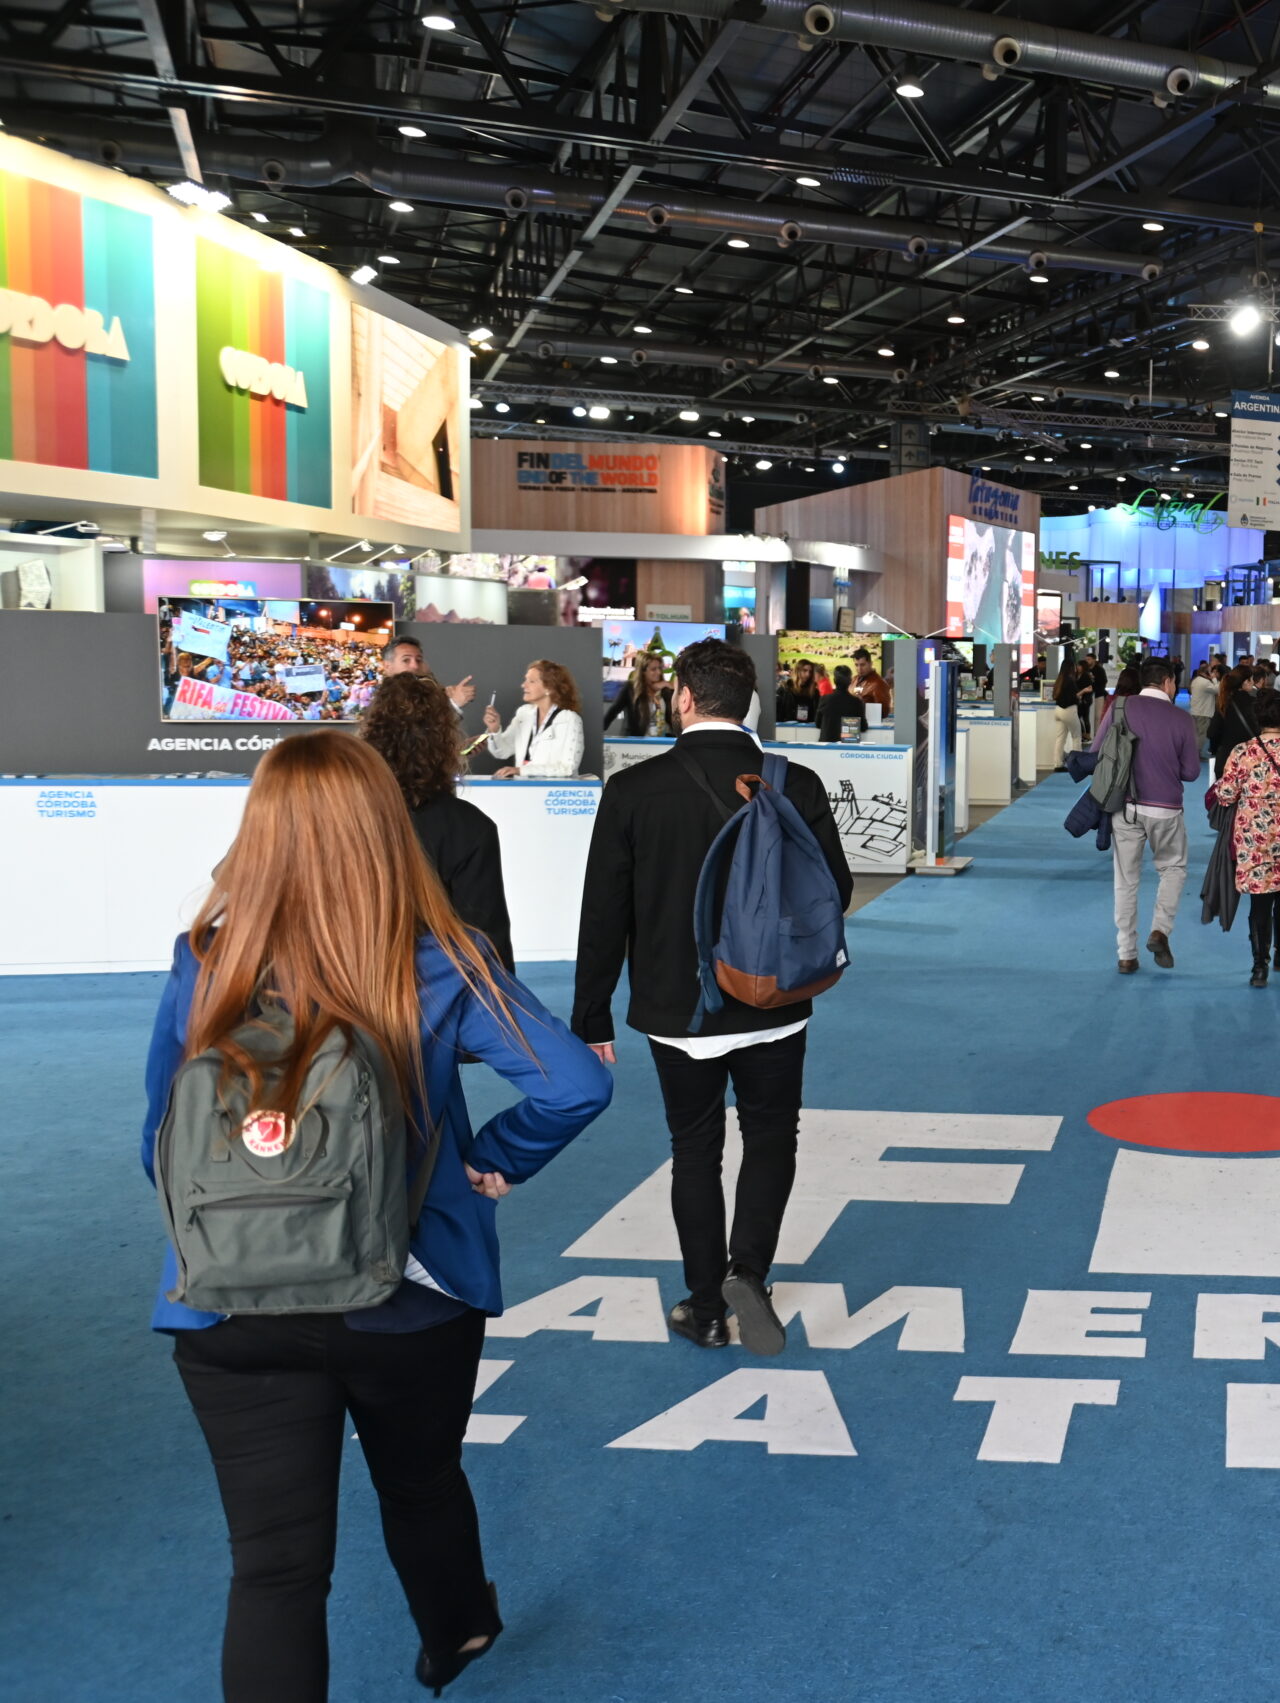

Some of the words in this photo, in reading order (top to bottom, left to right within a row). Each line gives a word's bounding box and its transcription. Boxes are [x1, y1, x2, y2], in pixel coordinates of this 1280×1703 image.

[517, 452, 550, 469] FIN
[588, 454, 657, 471] MUNDO
[549, 471, 568, 484] OF
[601, 472, 658, 486] WORLD
[177, 678, 213, 710] RIFA
[229, 693, 297, 720] FESTIVA
[147, 738, 233, 751] AGENCIA
[876, 753, 904, 761] CIUDAD
[39, 790, 94, 798] AGENCIA
[547, 790, 594, 798] AGENCIA
[37, 810, 96, 818] TURISMO
